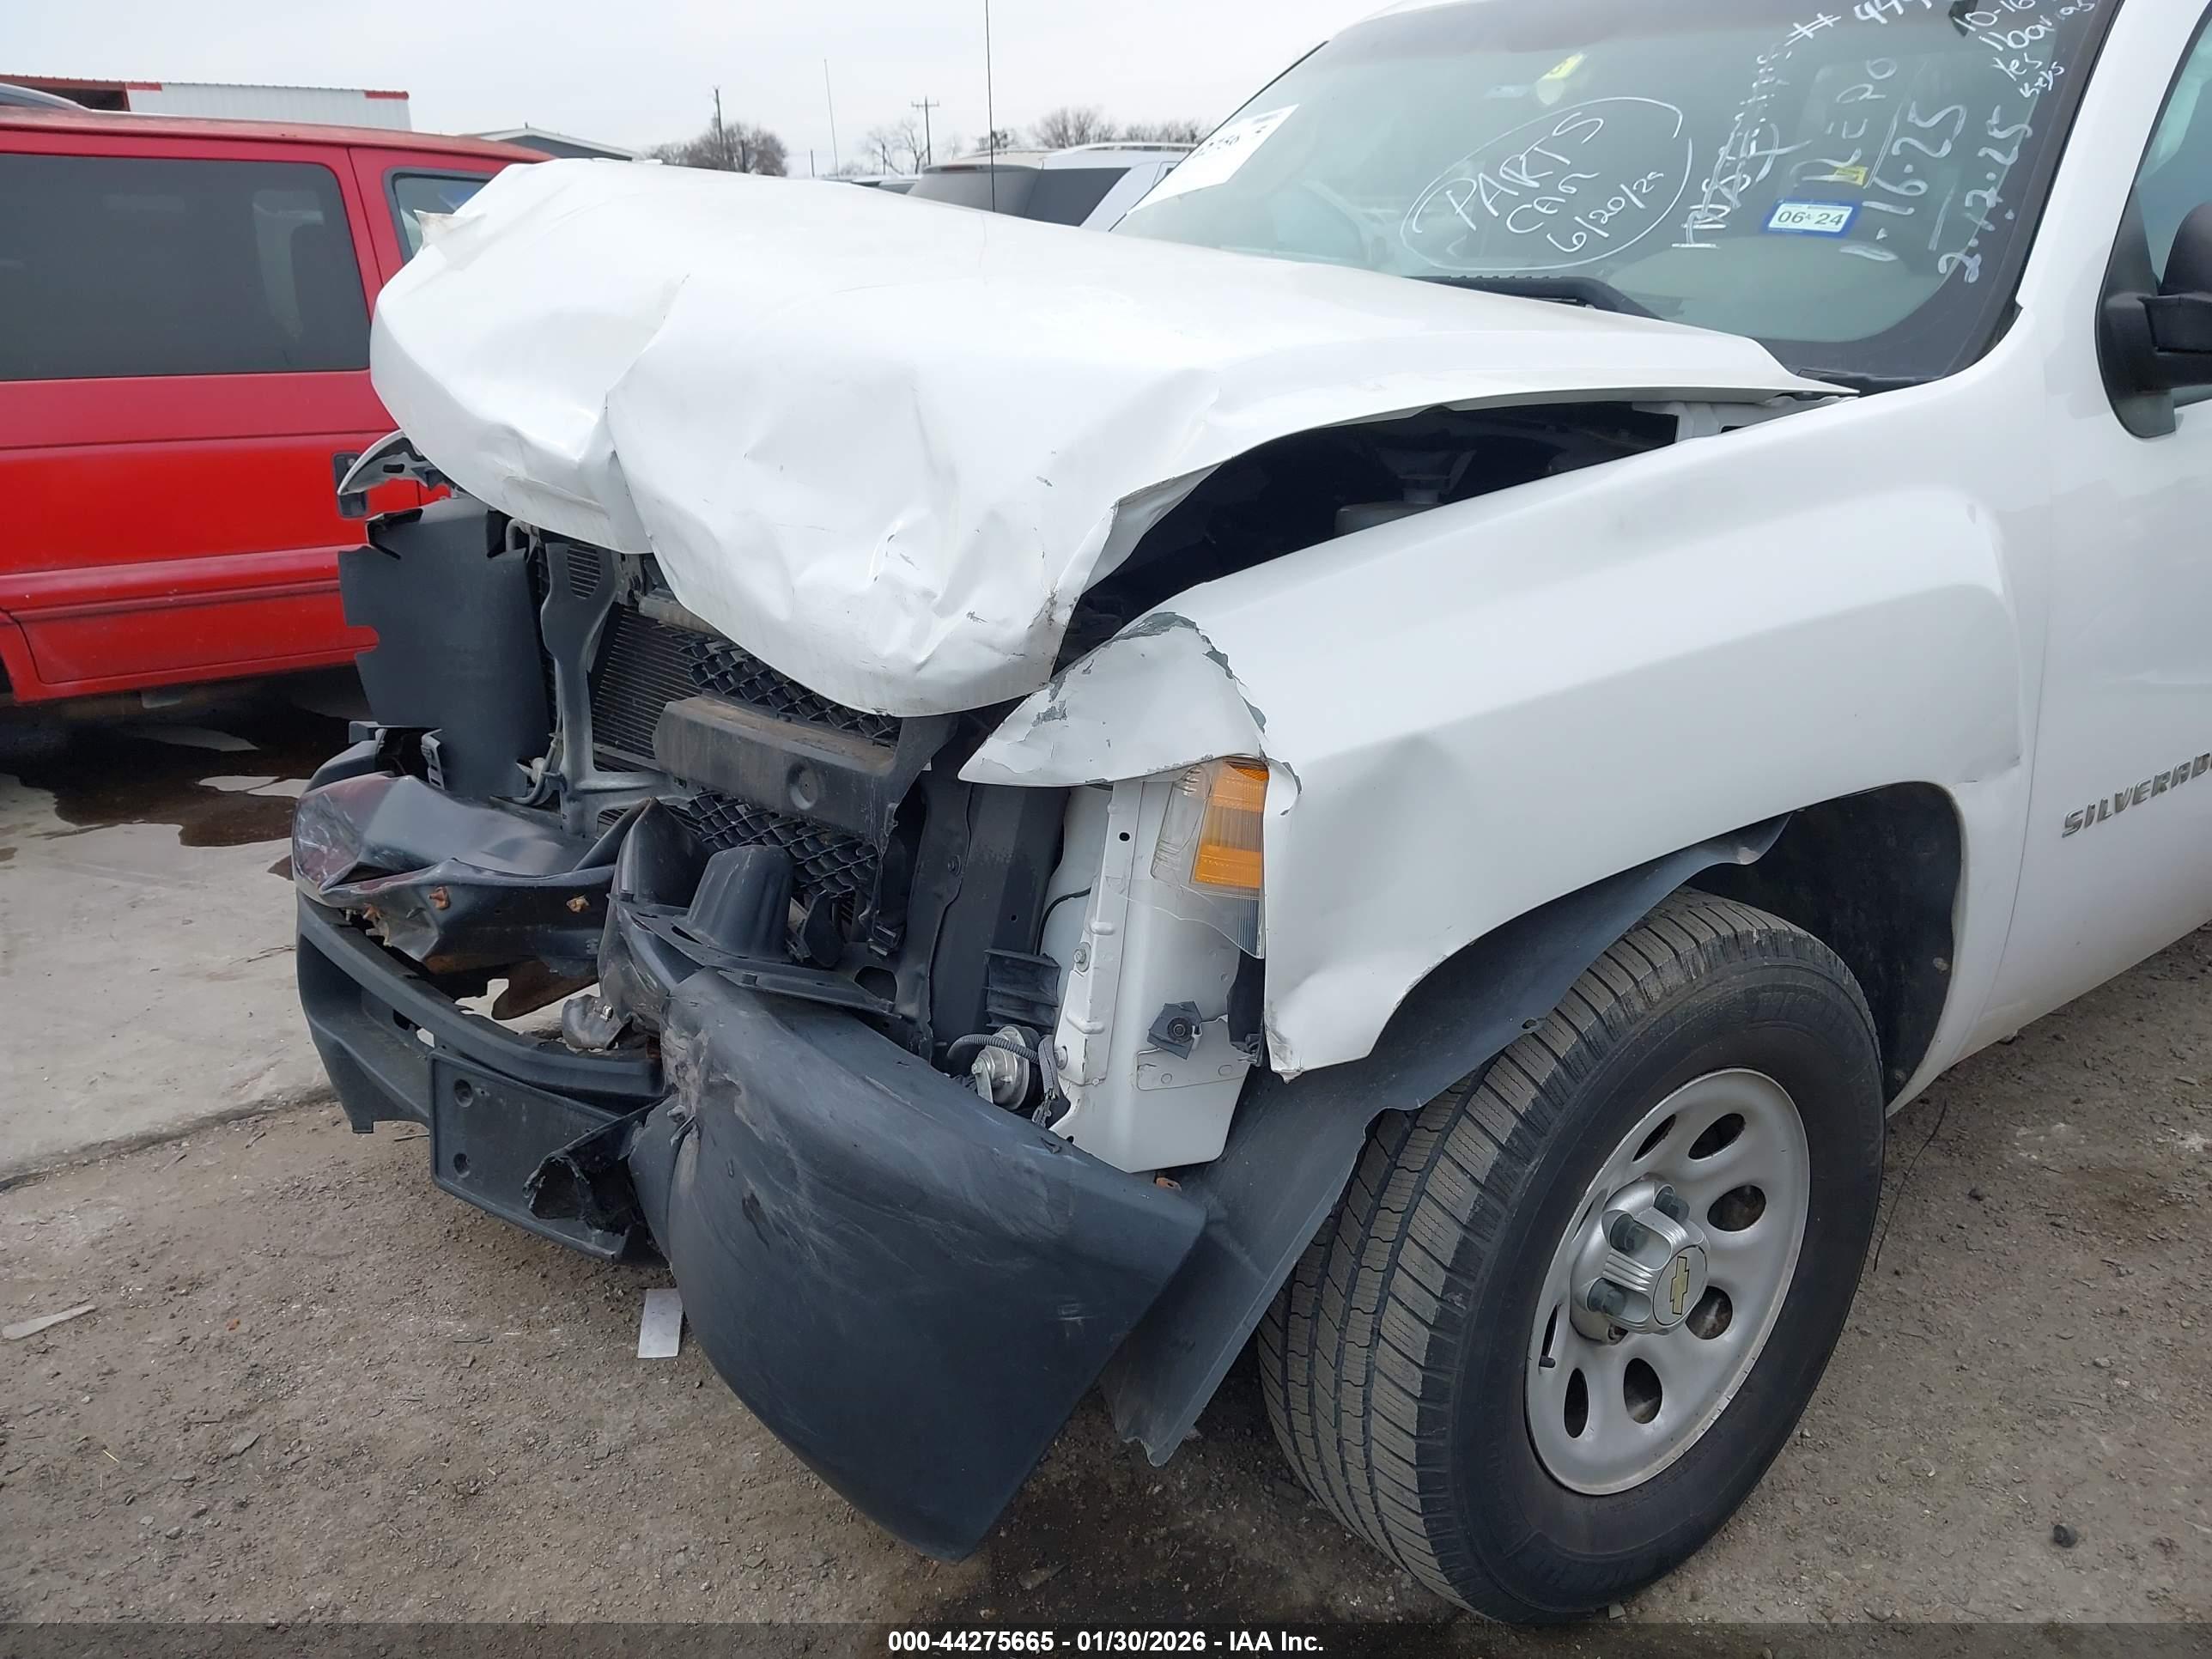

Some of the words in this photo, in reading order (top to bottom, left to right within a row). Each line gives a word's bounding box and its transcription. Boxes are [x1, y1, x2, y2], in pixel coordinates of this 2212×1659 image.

[1413, 111, 1604, 232] PARTS
[1778, 210, 1806, 223] 06
[1814, 213, 1845, 225] 24
[2062, 750, 2212, 839] SILVERAD
